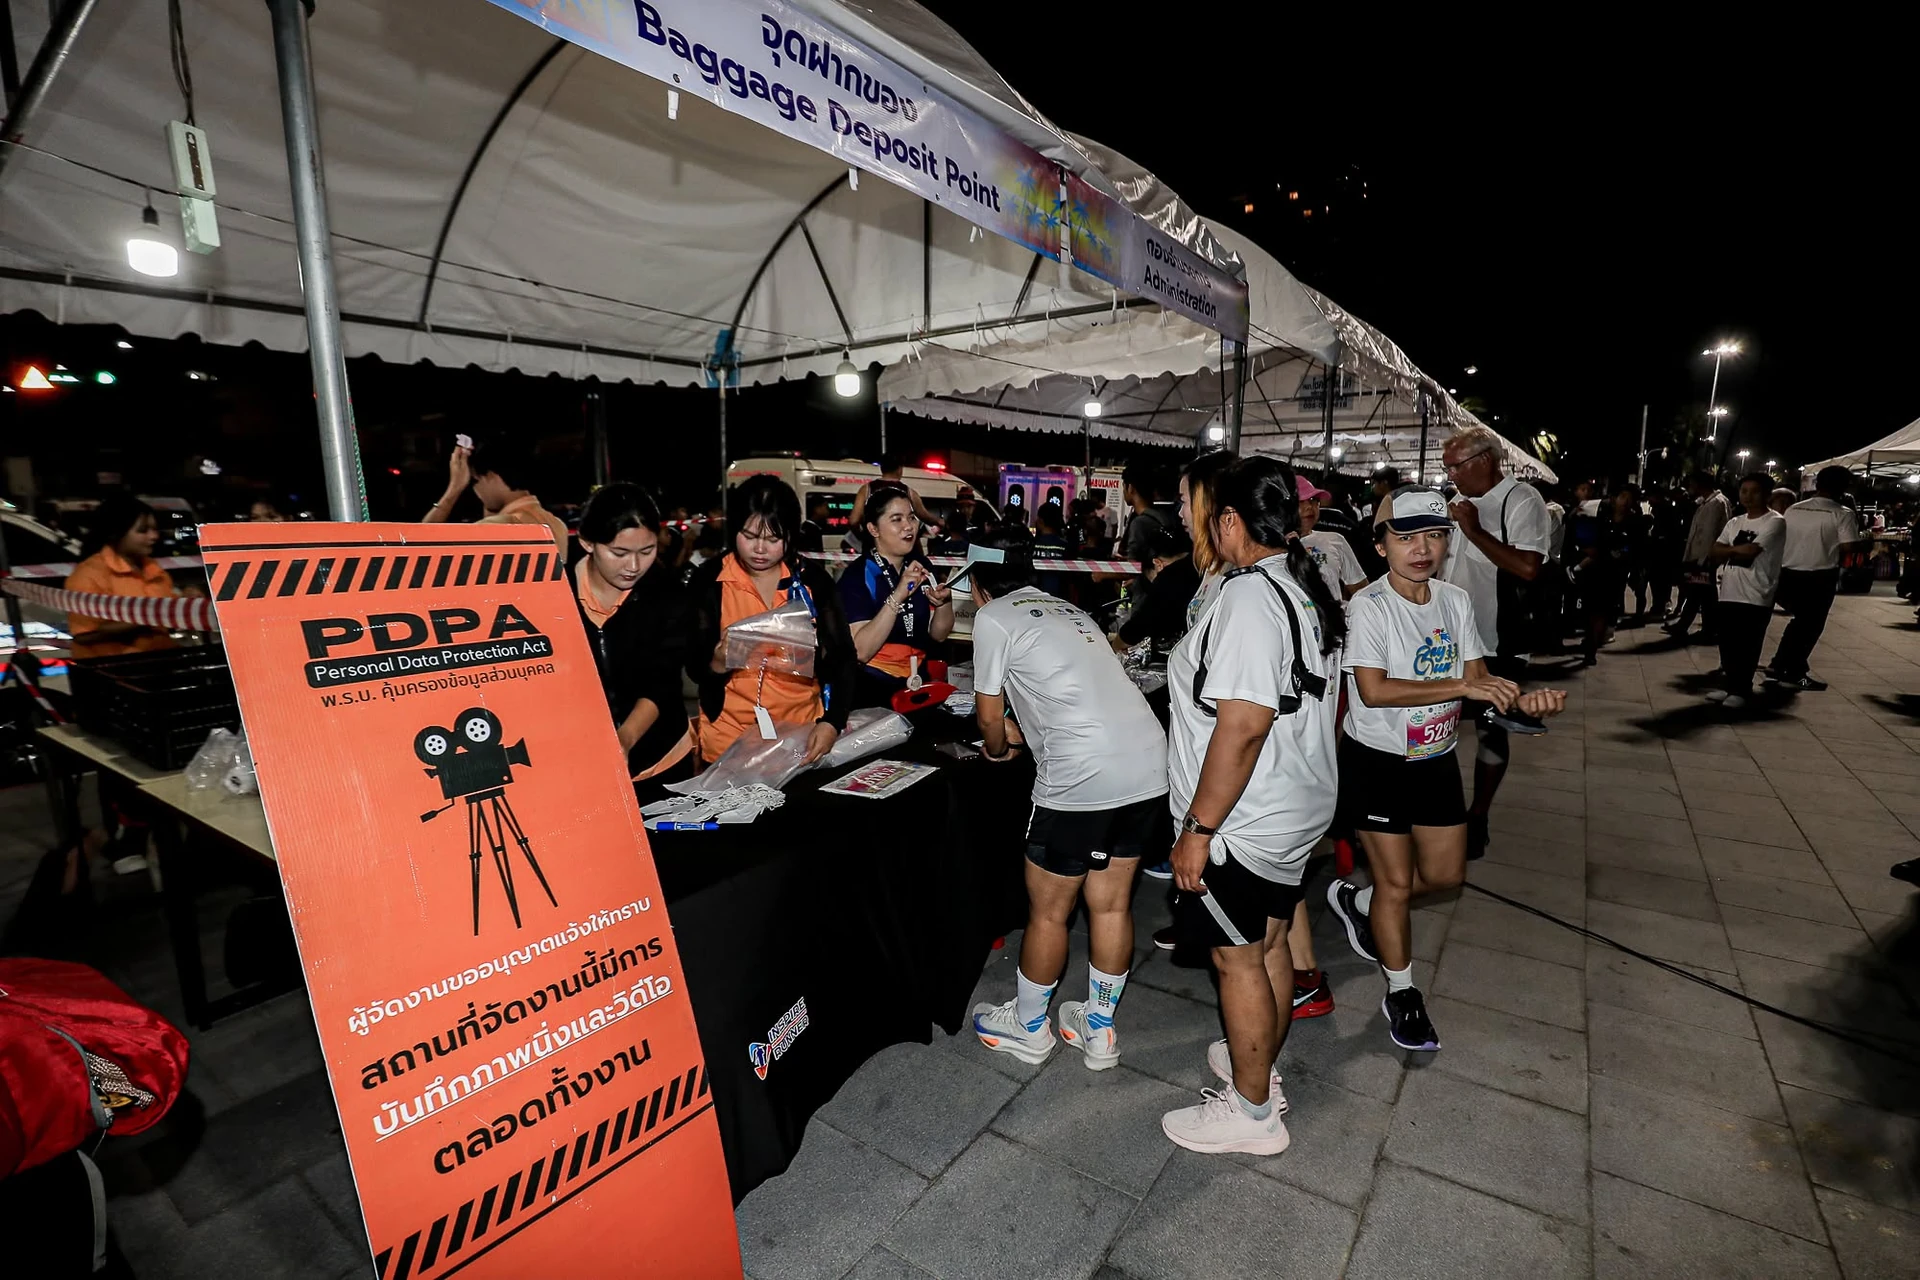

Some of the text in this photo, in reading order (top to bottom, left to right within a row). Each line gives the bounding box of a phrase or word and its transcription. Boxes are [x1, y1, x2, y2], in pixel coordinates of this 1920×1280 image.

[634, 0, 1001, 213] Baggage Deposit Point
[762, 13, 918, 122] จุดฝากของ
[1143, 264, 1218, 320] Administration
[300, 604, 541, 660] PDPA
[314, 641, 548, 682] Personal Data Protection Act
[320, 663, 555, 708] พ.ร.บ. คุ้มครองข้อมูลส่วนบุคคล
[348, 897, 651, 1036] ผู้จัดงานขออนุญาตแจ้งให้ทราบ
[361, 937, 663, 1090] สถานที่จัดงานนี้มีการ
[767, 996, 807, 1044] INSPIRE
[773, 1014, 810, 1061] RUNNER
[372, 975, 672, 1137] บันทึกภาพนิ่งและวิดีโอ
[433, 1038, 652, 1175] ตลอดทั้งงาน
